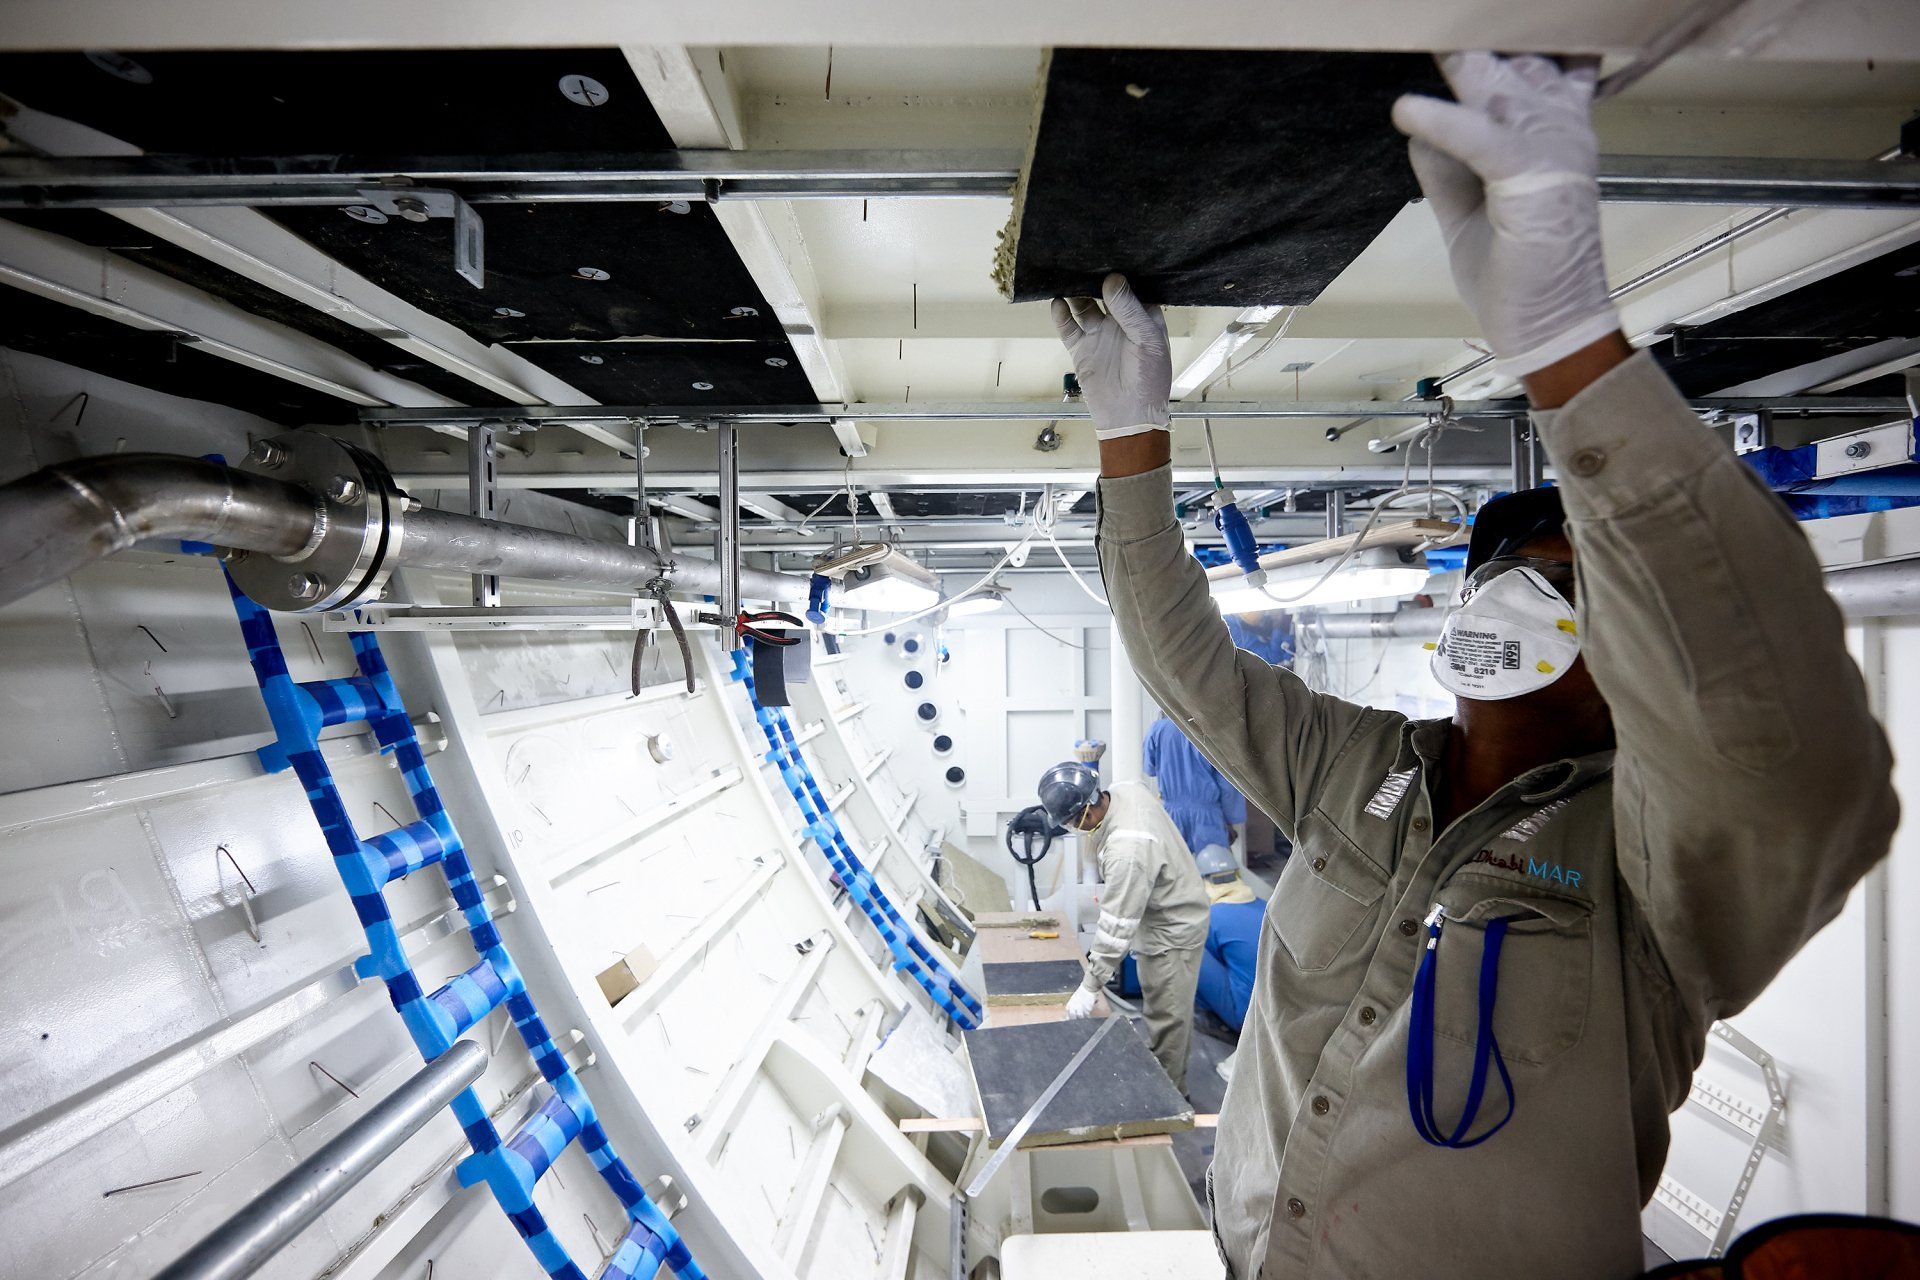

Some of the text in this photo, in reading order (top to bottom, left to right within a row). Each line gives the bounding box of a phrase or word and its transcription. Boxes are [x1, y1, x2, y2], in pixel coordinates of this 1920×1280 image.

[1457, 630, 1497, 640] WARNING
[1505, 644, 1518, 668] N95
[1450, 662, 1466, 672] 3M
[1474, 667, 1496, 676] 8210
[1528, 856, 1582, 889] MAR
